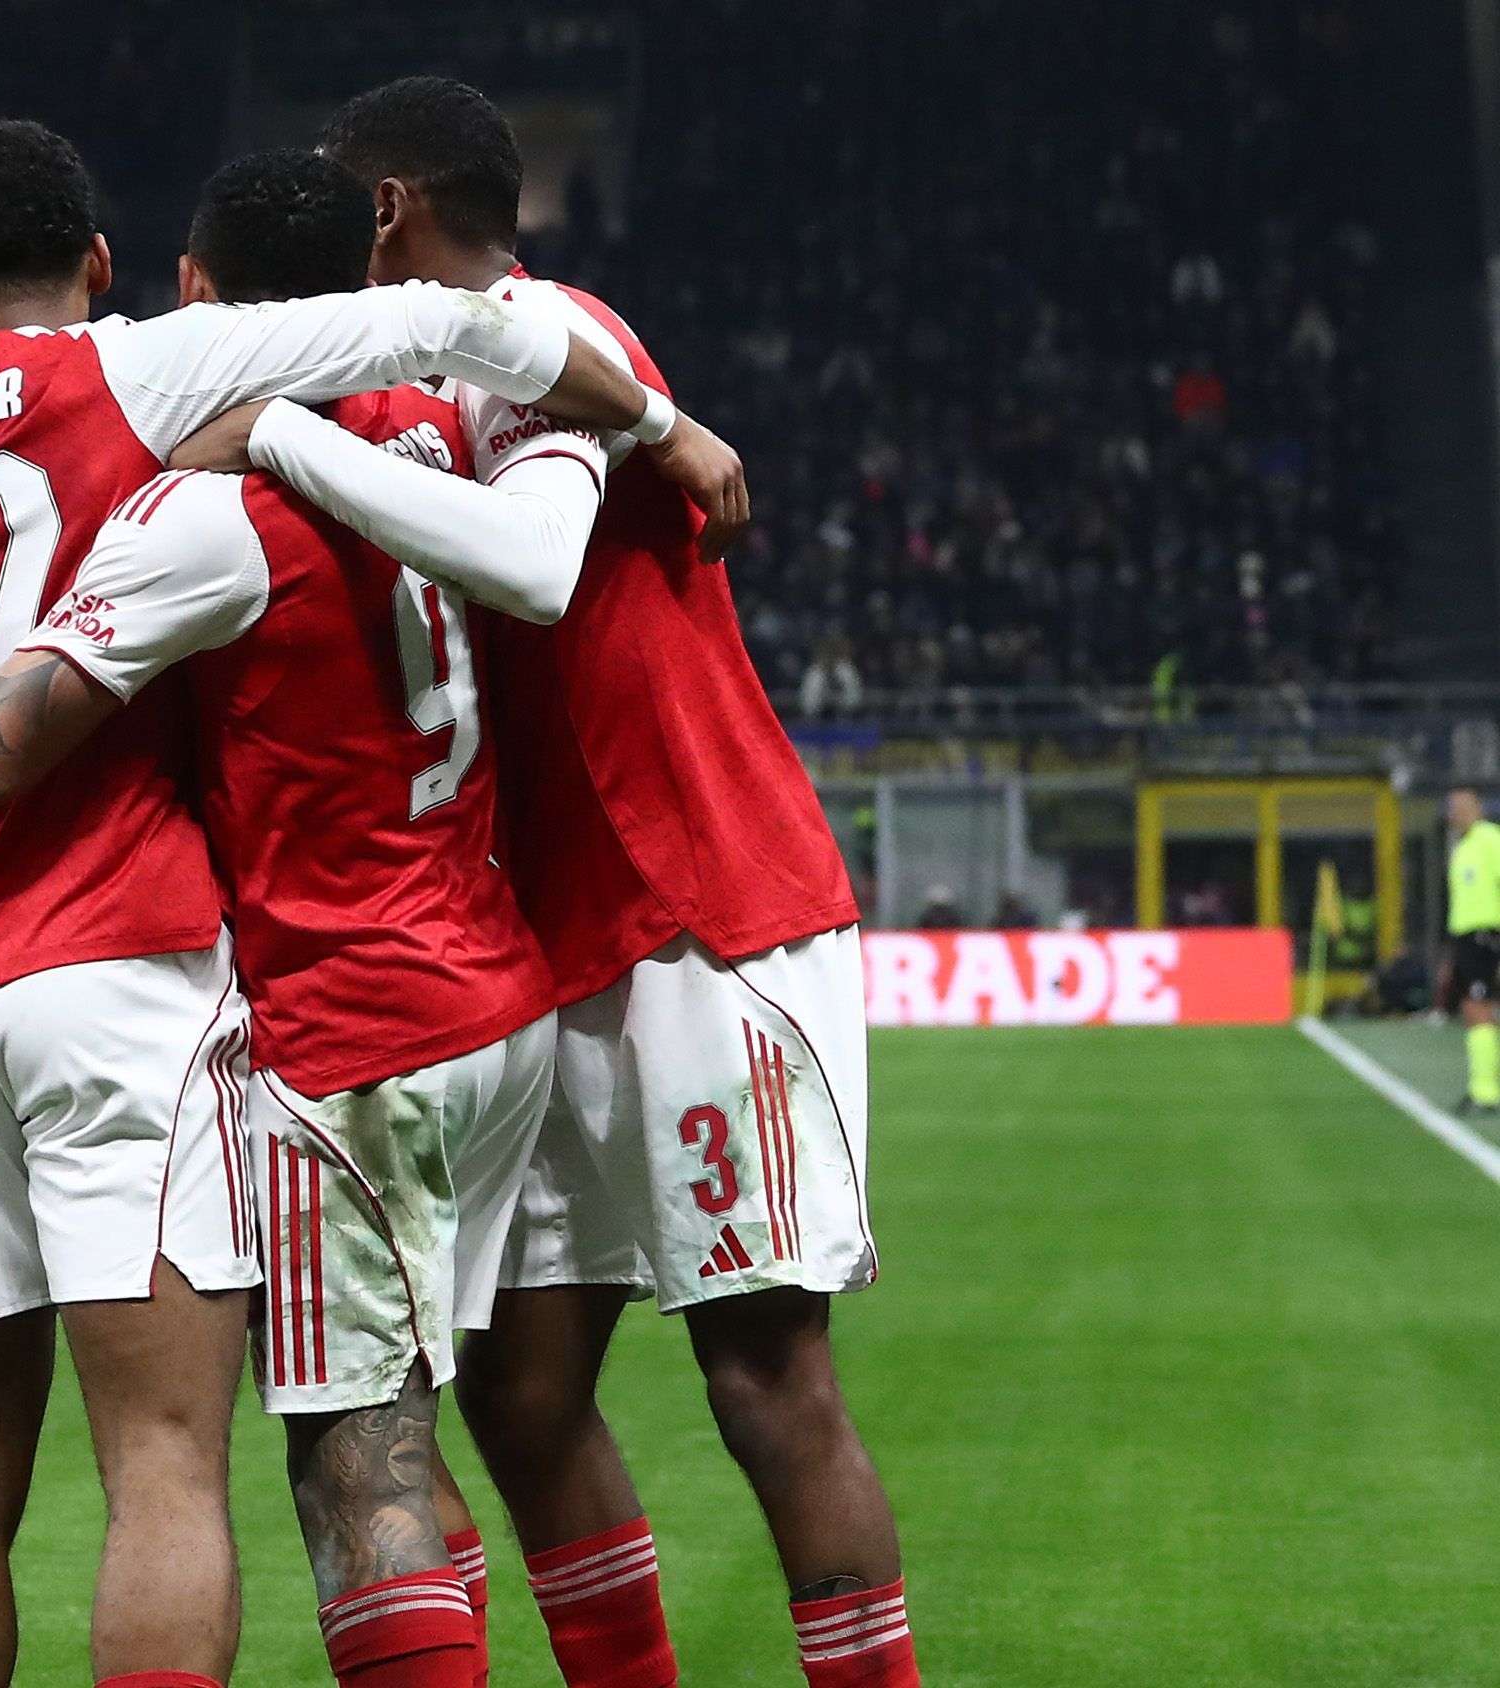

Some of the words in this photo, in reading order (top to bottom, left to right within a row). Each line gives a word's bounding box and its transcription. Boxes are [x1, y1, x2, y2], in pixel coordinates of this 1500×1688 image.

[391, 567, 482, 822] 9
[861, 929, 1180, 1026] RADE
[676, 1102, 741, 1218] 3
